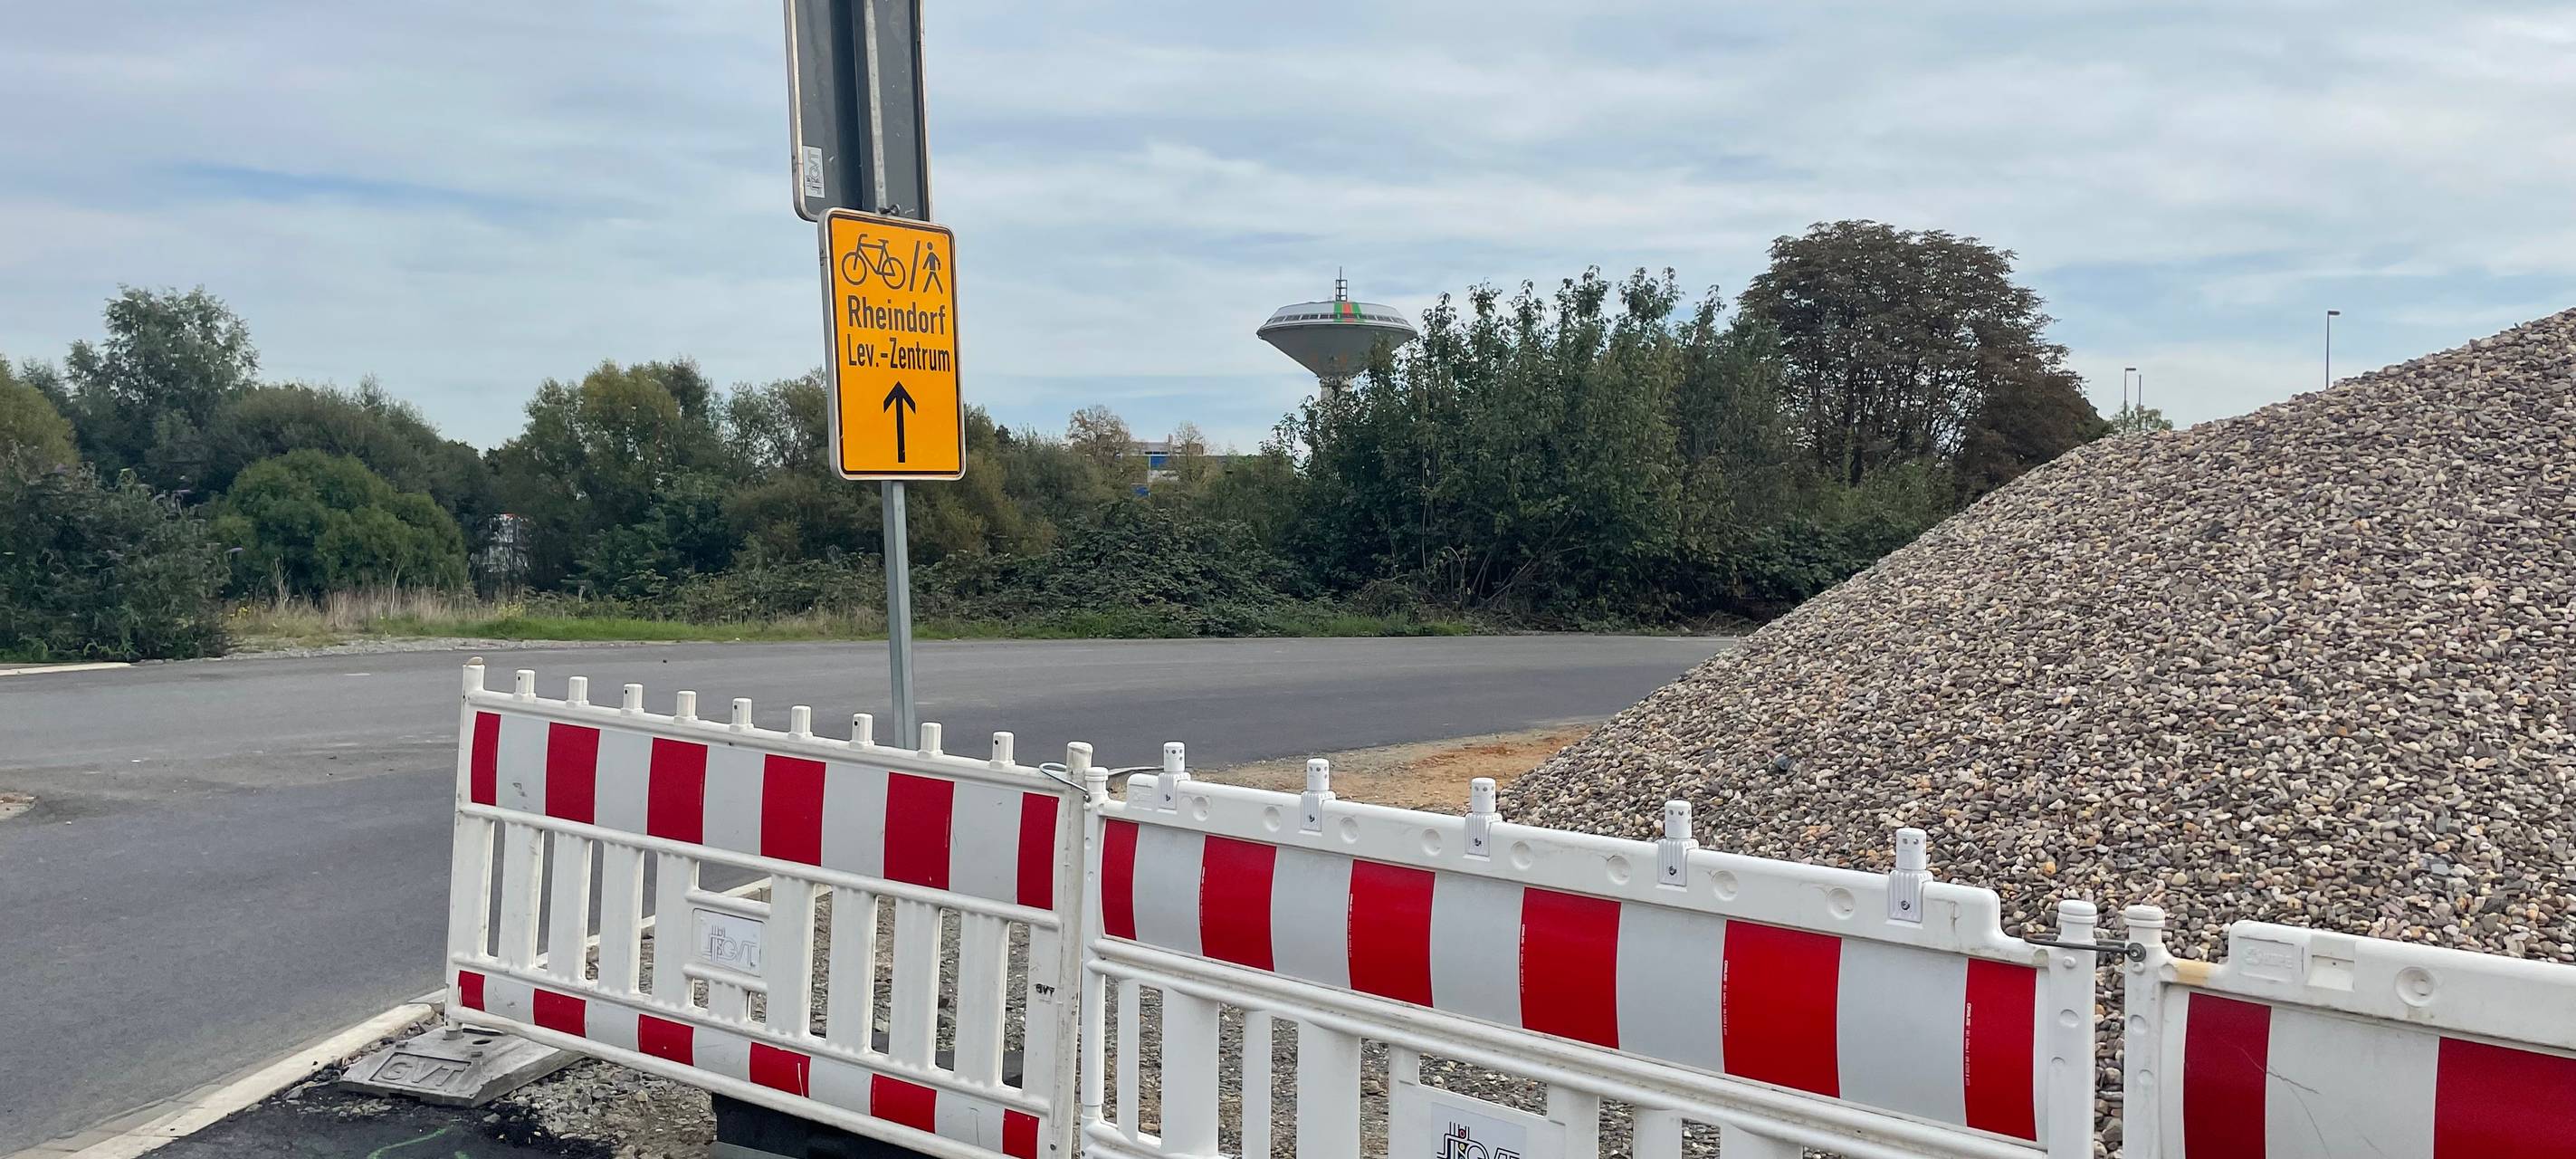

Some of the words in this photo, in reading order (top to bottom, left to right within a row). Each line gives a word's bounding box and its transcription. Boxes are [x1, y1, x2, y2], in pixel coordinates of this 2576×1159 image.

[847, 294, 946, 335] Rheindorf
[847, 333, 950, 372] Lev.-Zentrum
[381, 1061, 466, 1087] GVT
